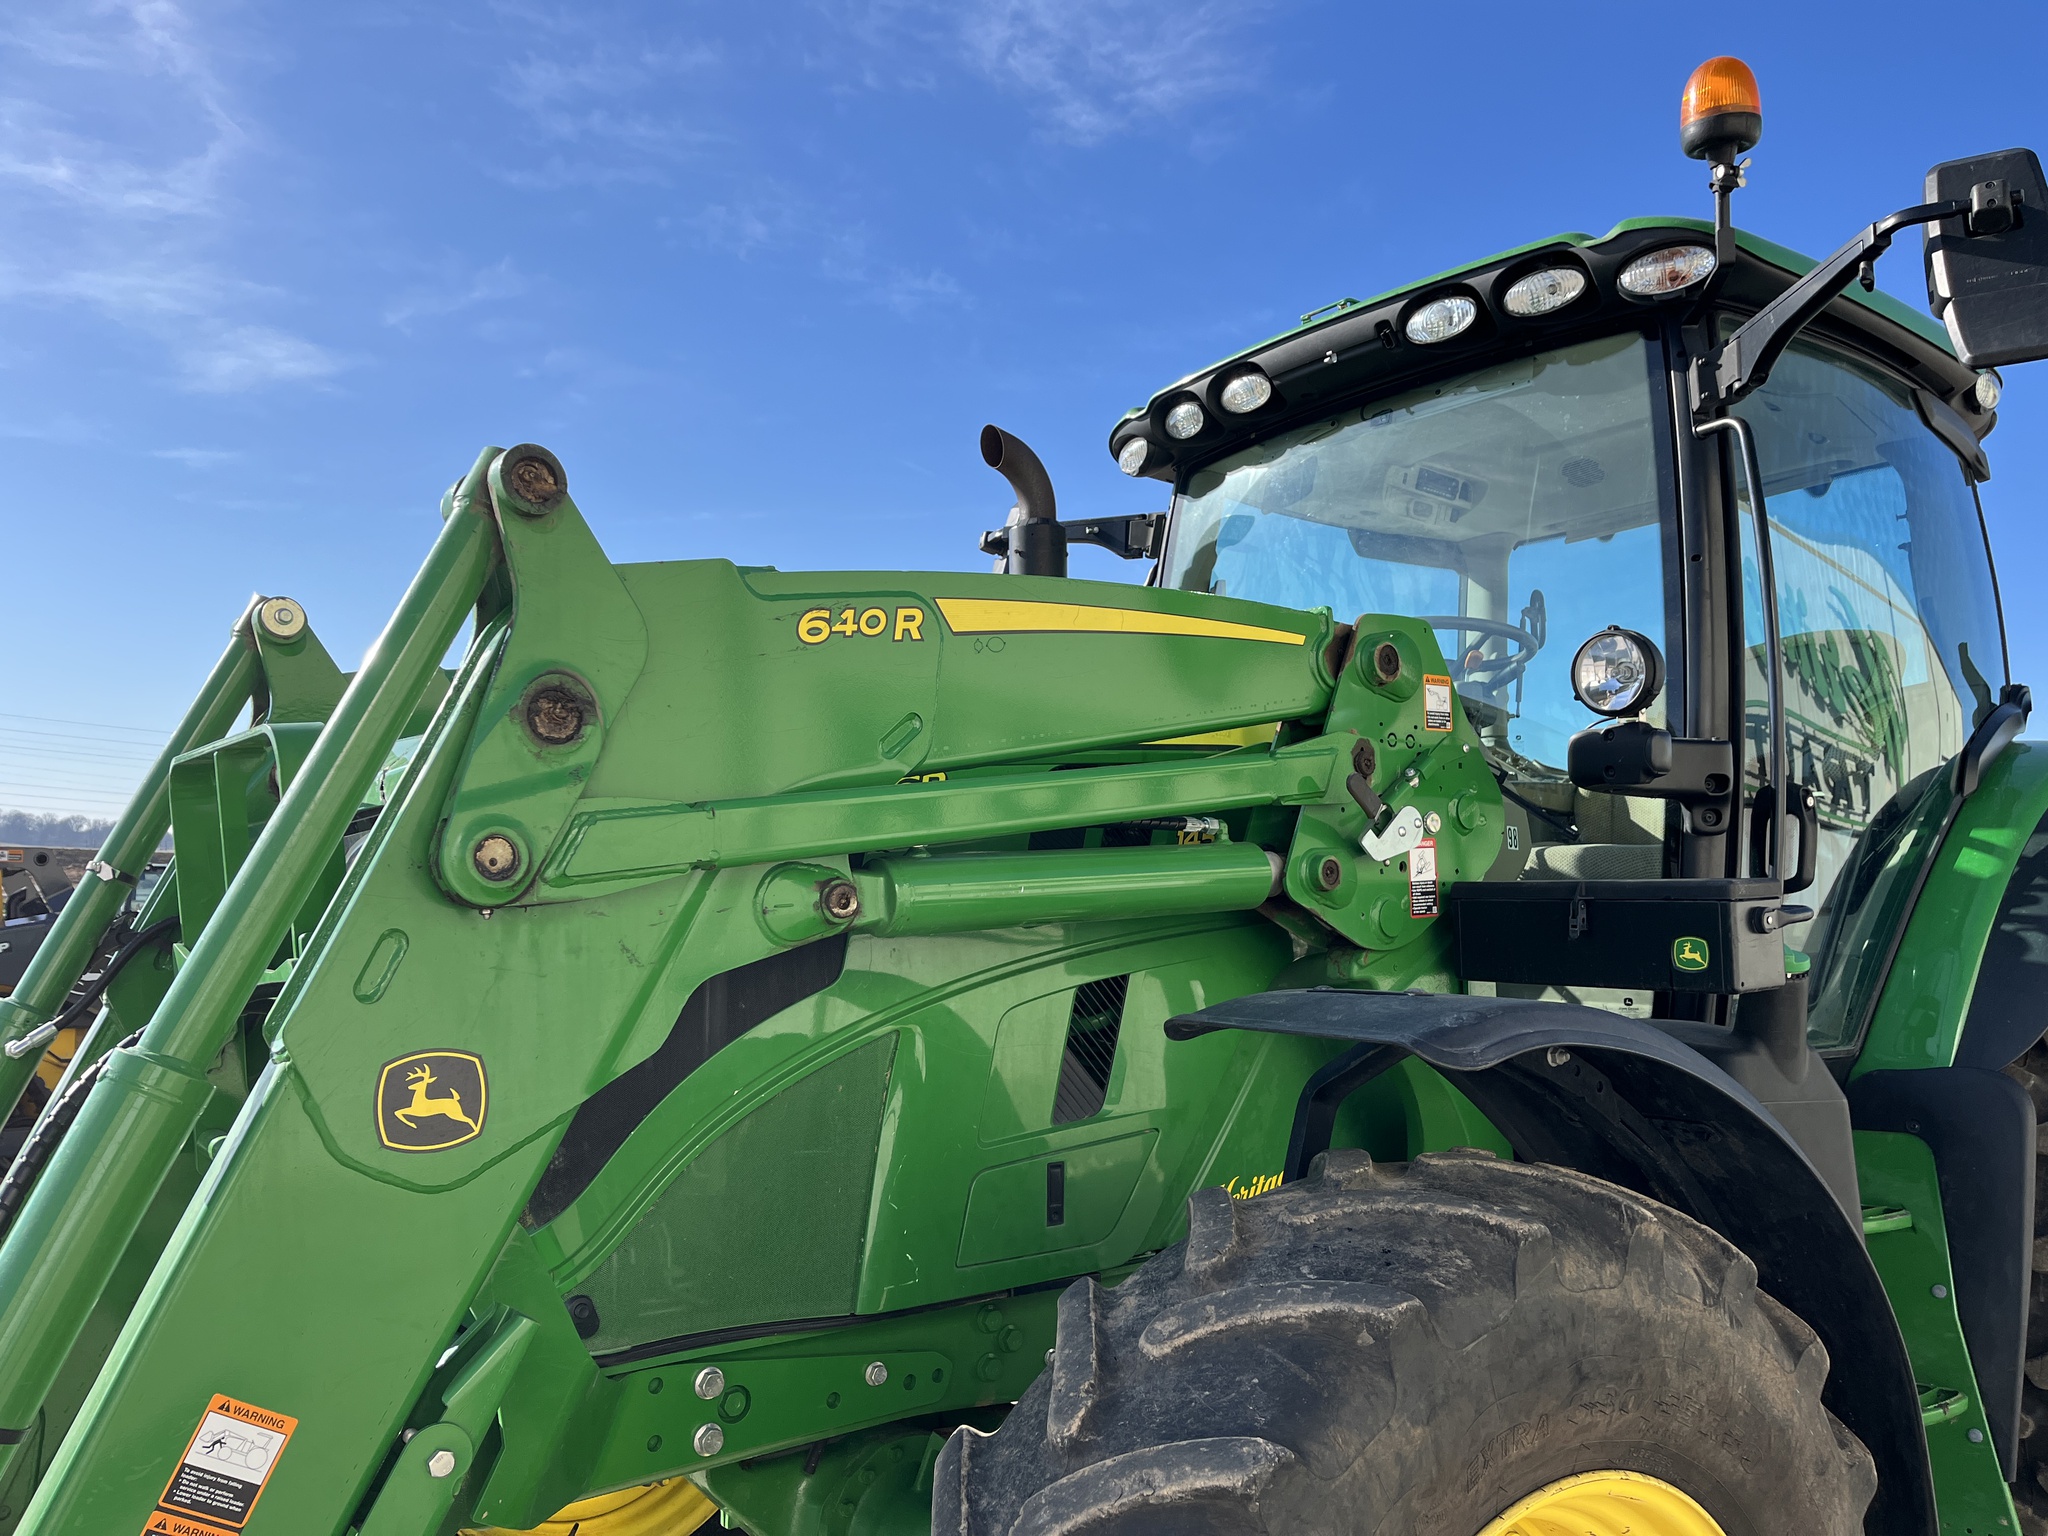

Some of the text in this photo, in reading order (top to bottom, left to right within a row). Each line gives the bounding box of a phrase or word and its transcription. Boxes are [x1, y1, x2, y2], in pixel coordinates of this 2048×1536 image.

[1508, 827, 1517, 848] 98
[233, 1405, 286, 1430] WARNING
[1466, 1413, 1551, 1494] EXTRA
[190, 1469, 203, 1477] avoid
[204, 1472, 216, 1482] injury
[216, 1476, 228, 1484] from
[176, 1490, 191, 1498] Lower
[191, 1493, 207, 1502] loader
[211, 1499, 229, 1509] ground
[179, 1485, 196, 1493] service
[197, 1489, 211, 1497] under
[198, 1482, 209, 1491] walk
[214, 1488, 234, 1498] perform
